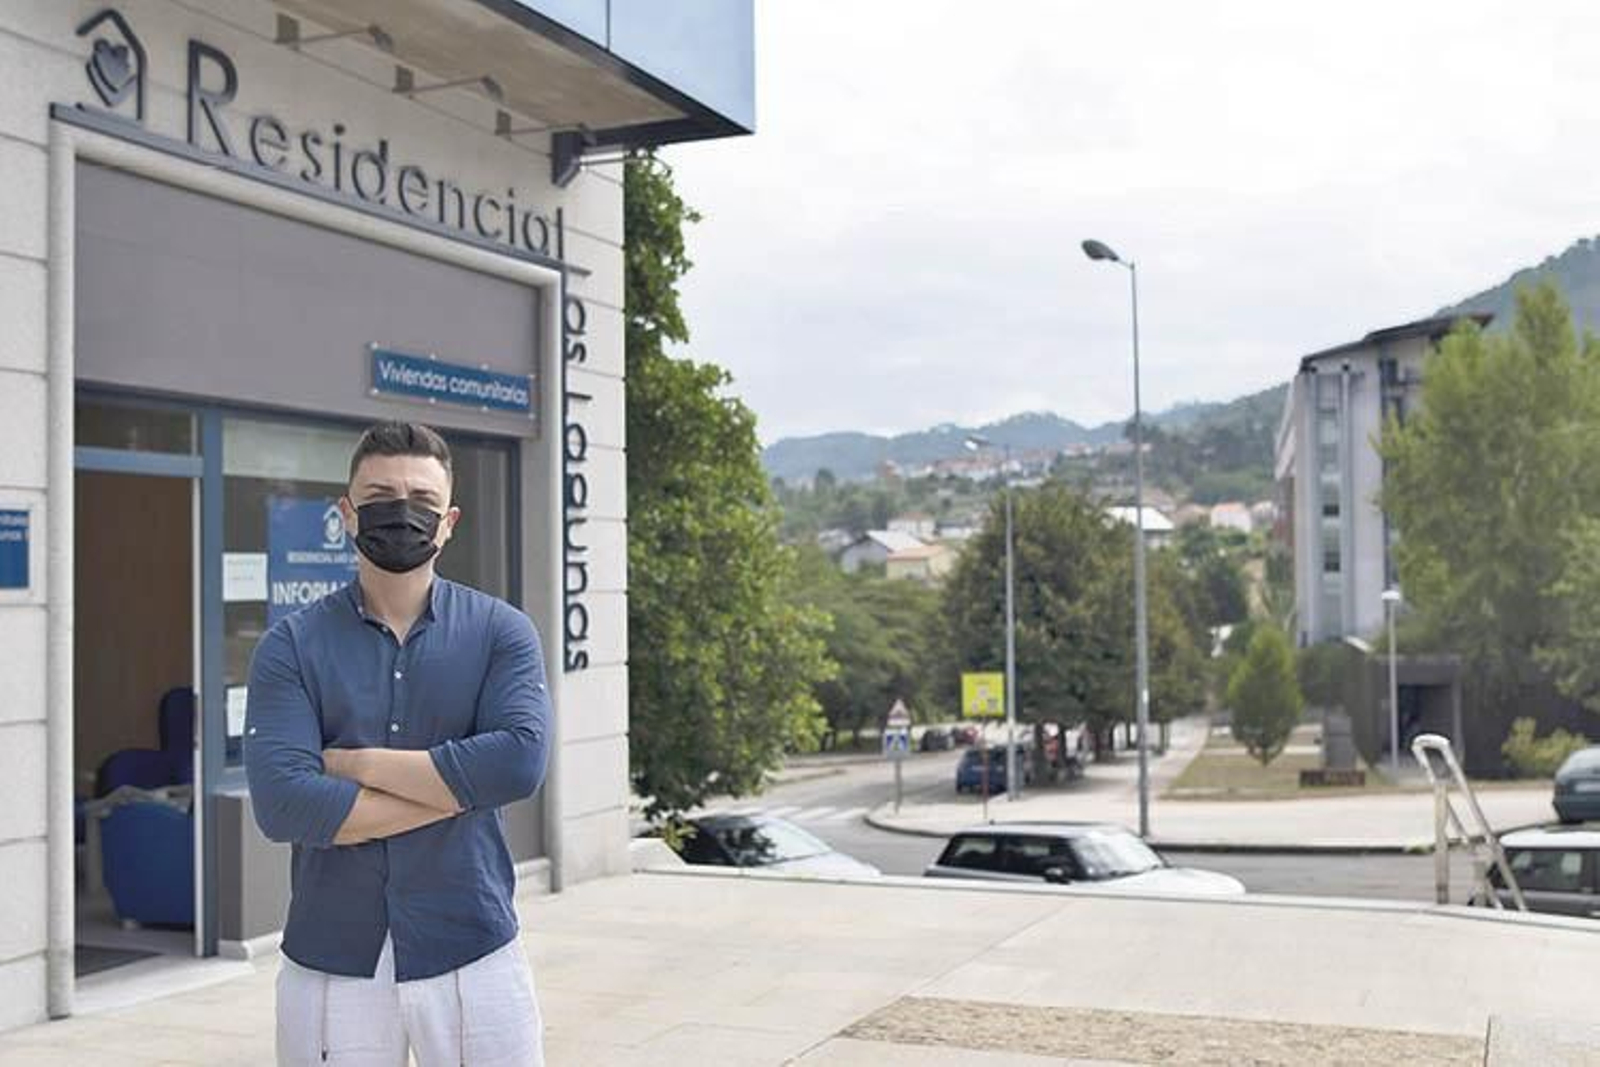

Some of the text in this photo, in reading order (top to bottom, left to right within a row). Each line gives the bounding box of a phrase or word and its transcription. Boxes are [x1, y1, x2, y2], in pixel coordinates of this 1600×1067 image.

[187, 38, 563, 260] Residencial
[378, 359, 528, 406] Viviendas comunitarias
